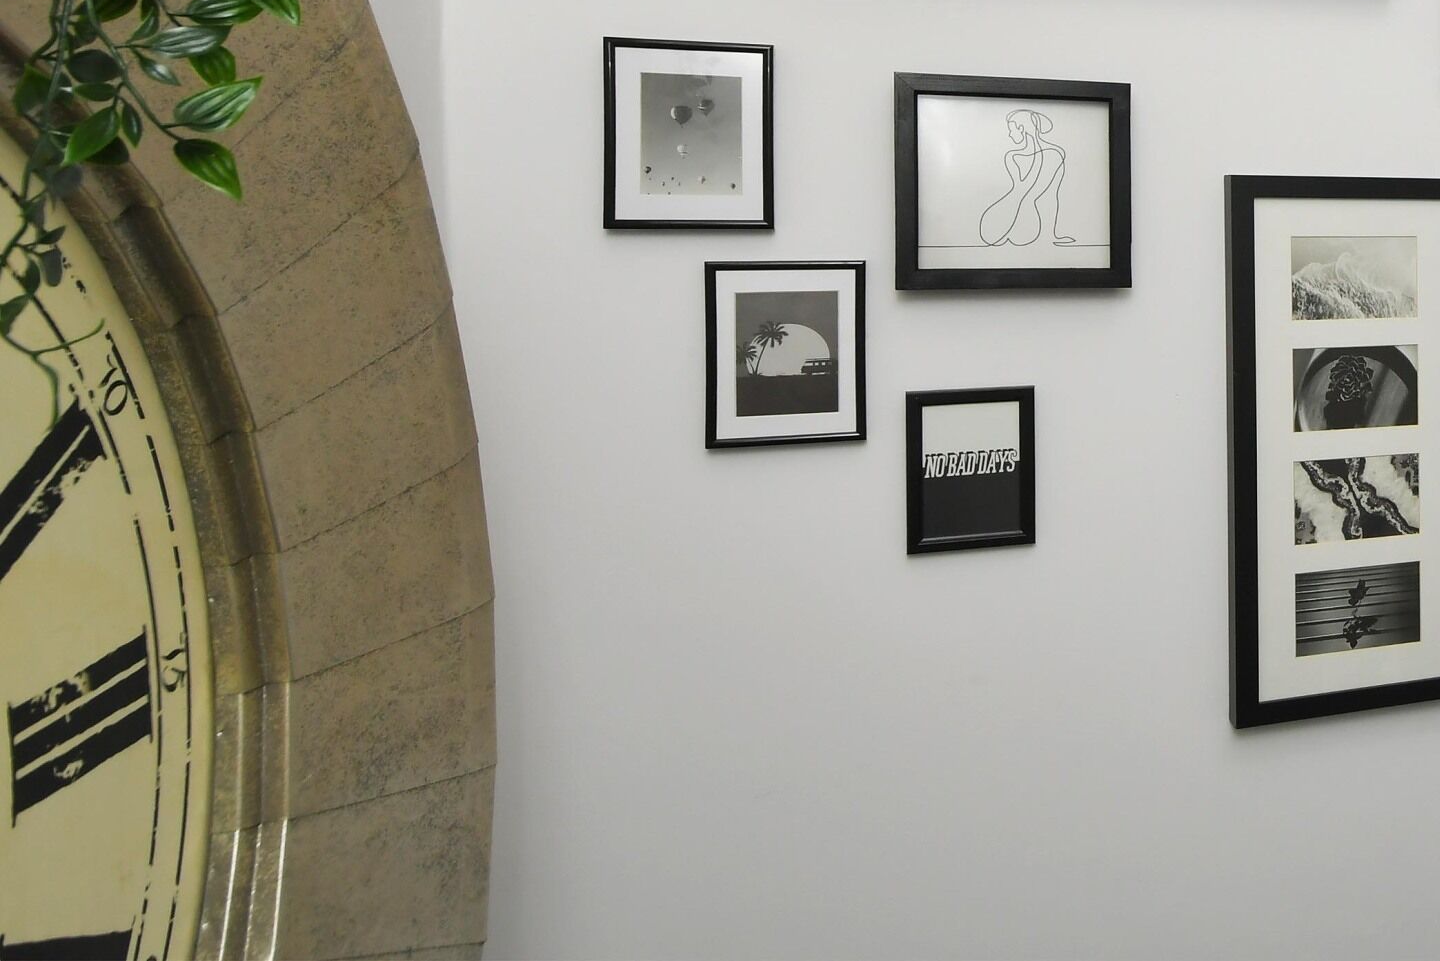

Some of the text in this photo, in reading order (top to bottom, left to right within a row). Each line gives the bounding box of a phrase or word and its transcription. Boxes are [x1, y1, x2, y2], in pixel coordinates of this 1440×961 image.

[924, 448, 1018, 479] NO BAD DAYS
